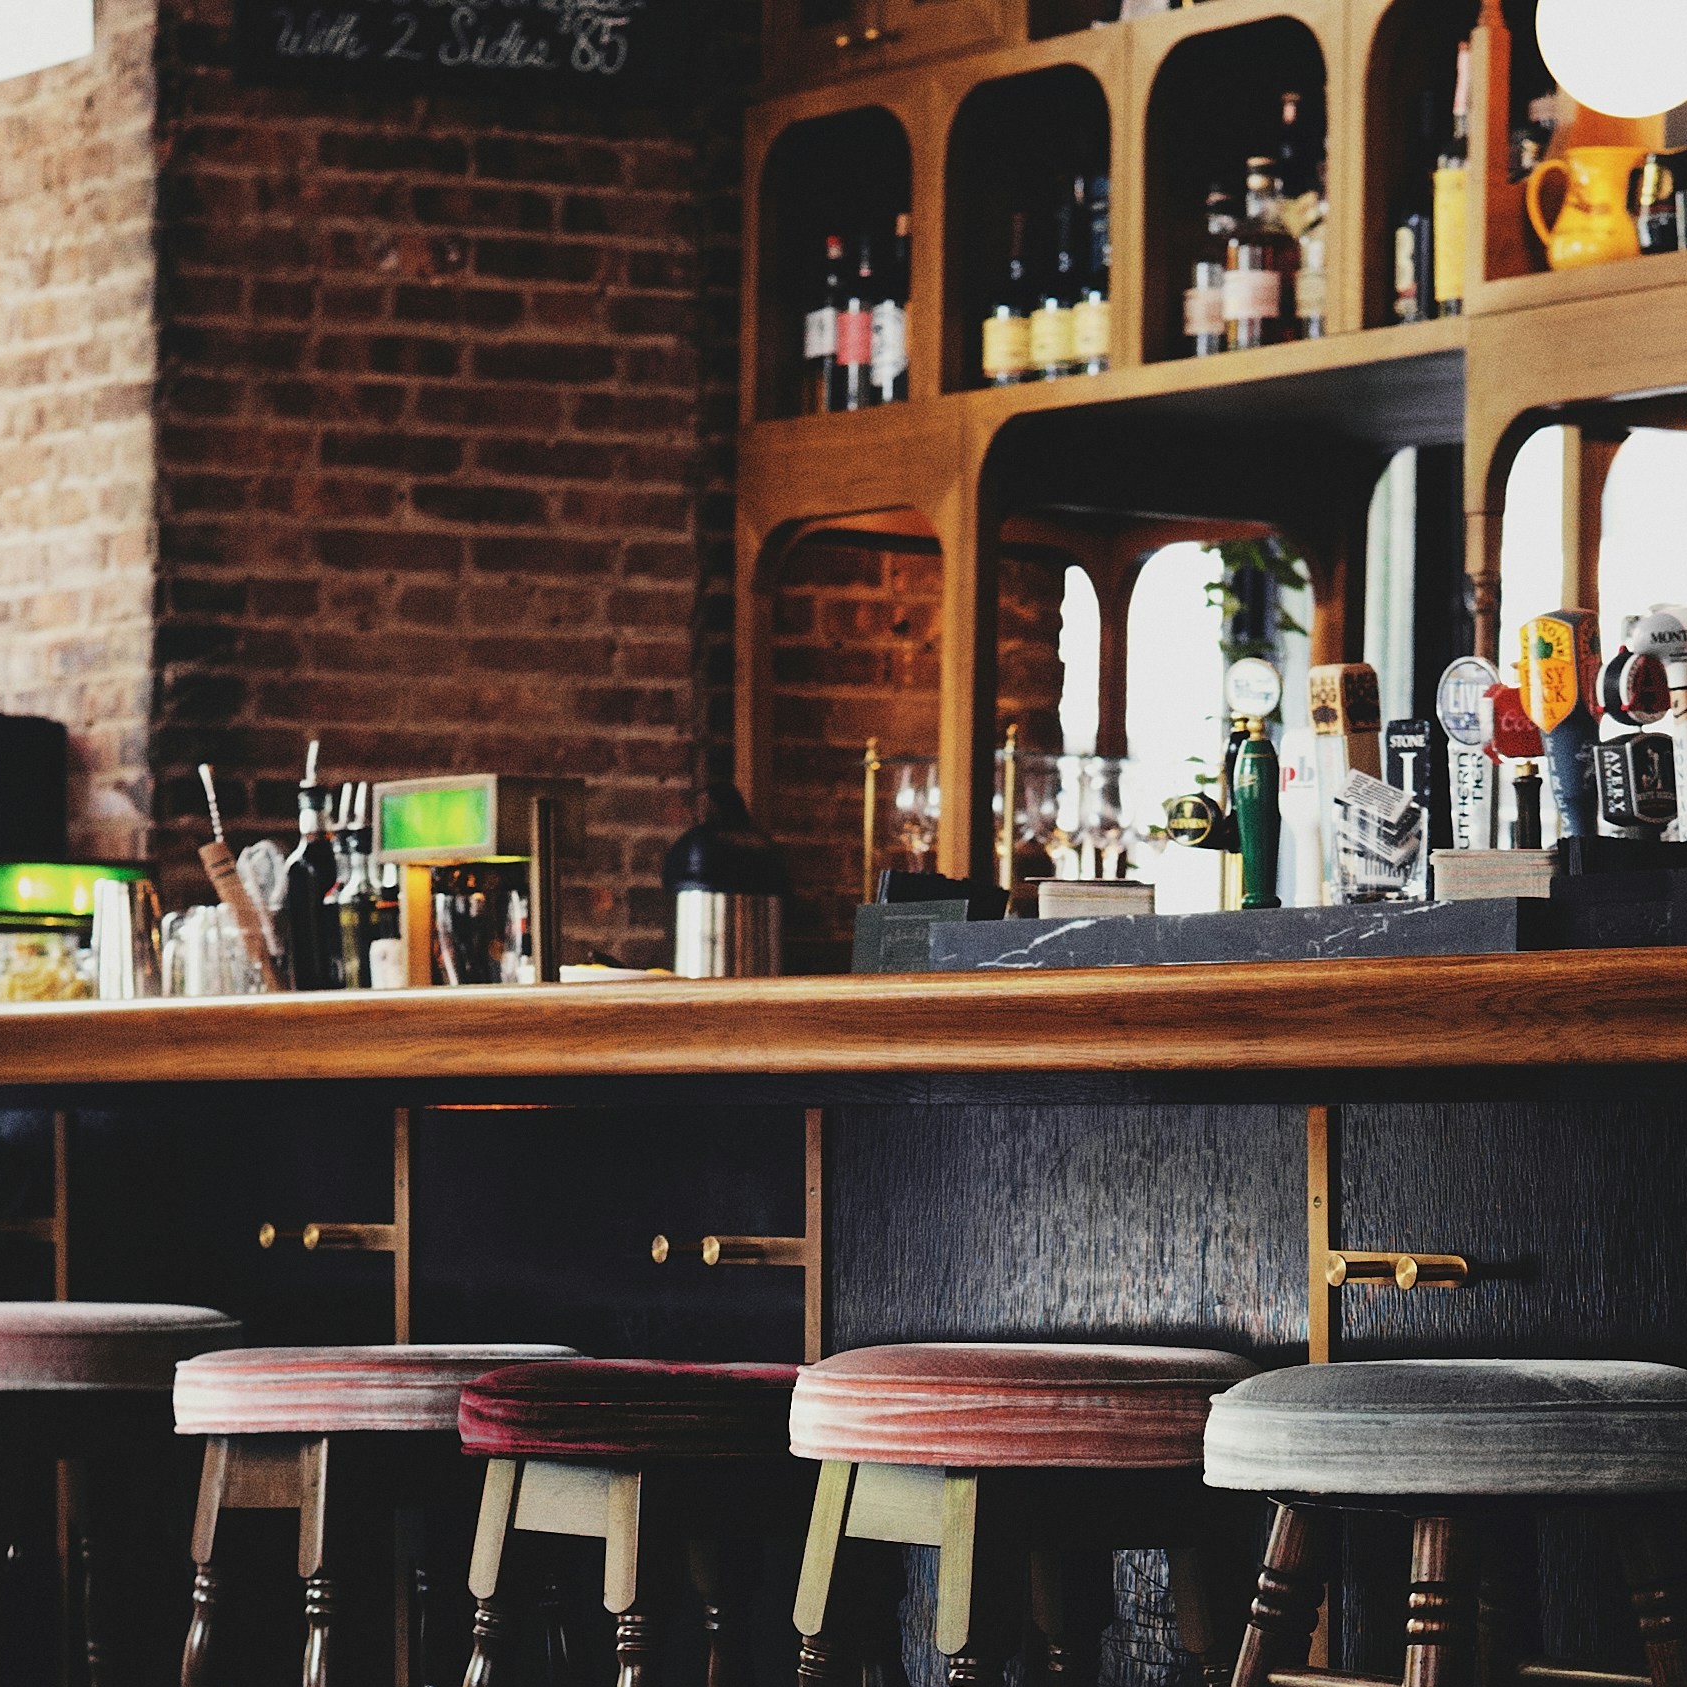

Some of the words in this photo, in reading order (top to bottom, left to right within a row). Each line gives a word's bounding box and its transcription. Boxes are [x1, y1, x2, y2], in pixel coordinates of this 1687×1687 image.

[384, 12, 422, 60] 2
[438, 6, 560, 67] Sides
[1389, 734, 1426, 749] STONE
[1471, 751, 1484, 806] TIER
[1609, 750, 1627, 813] AVERY
